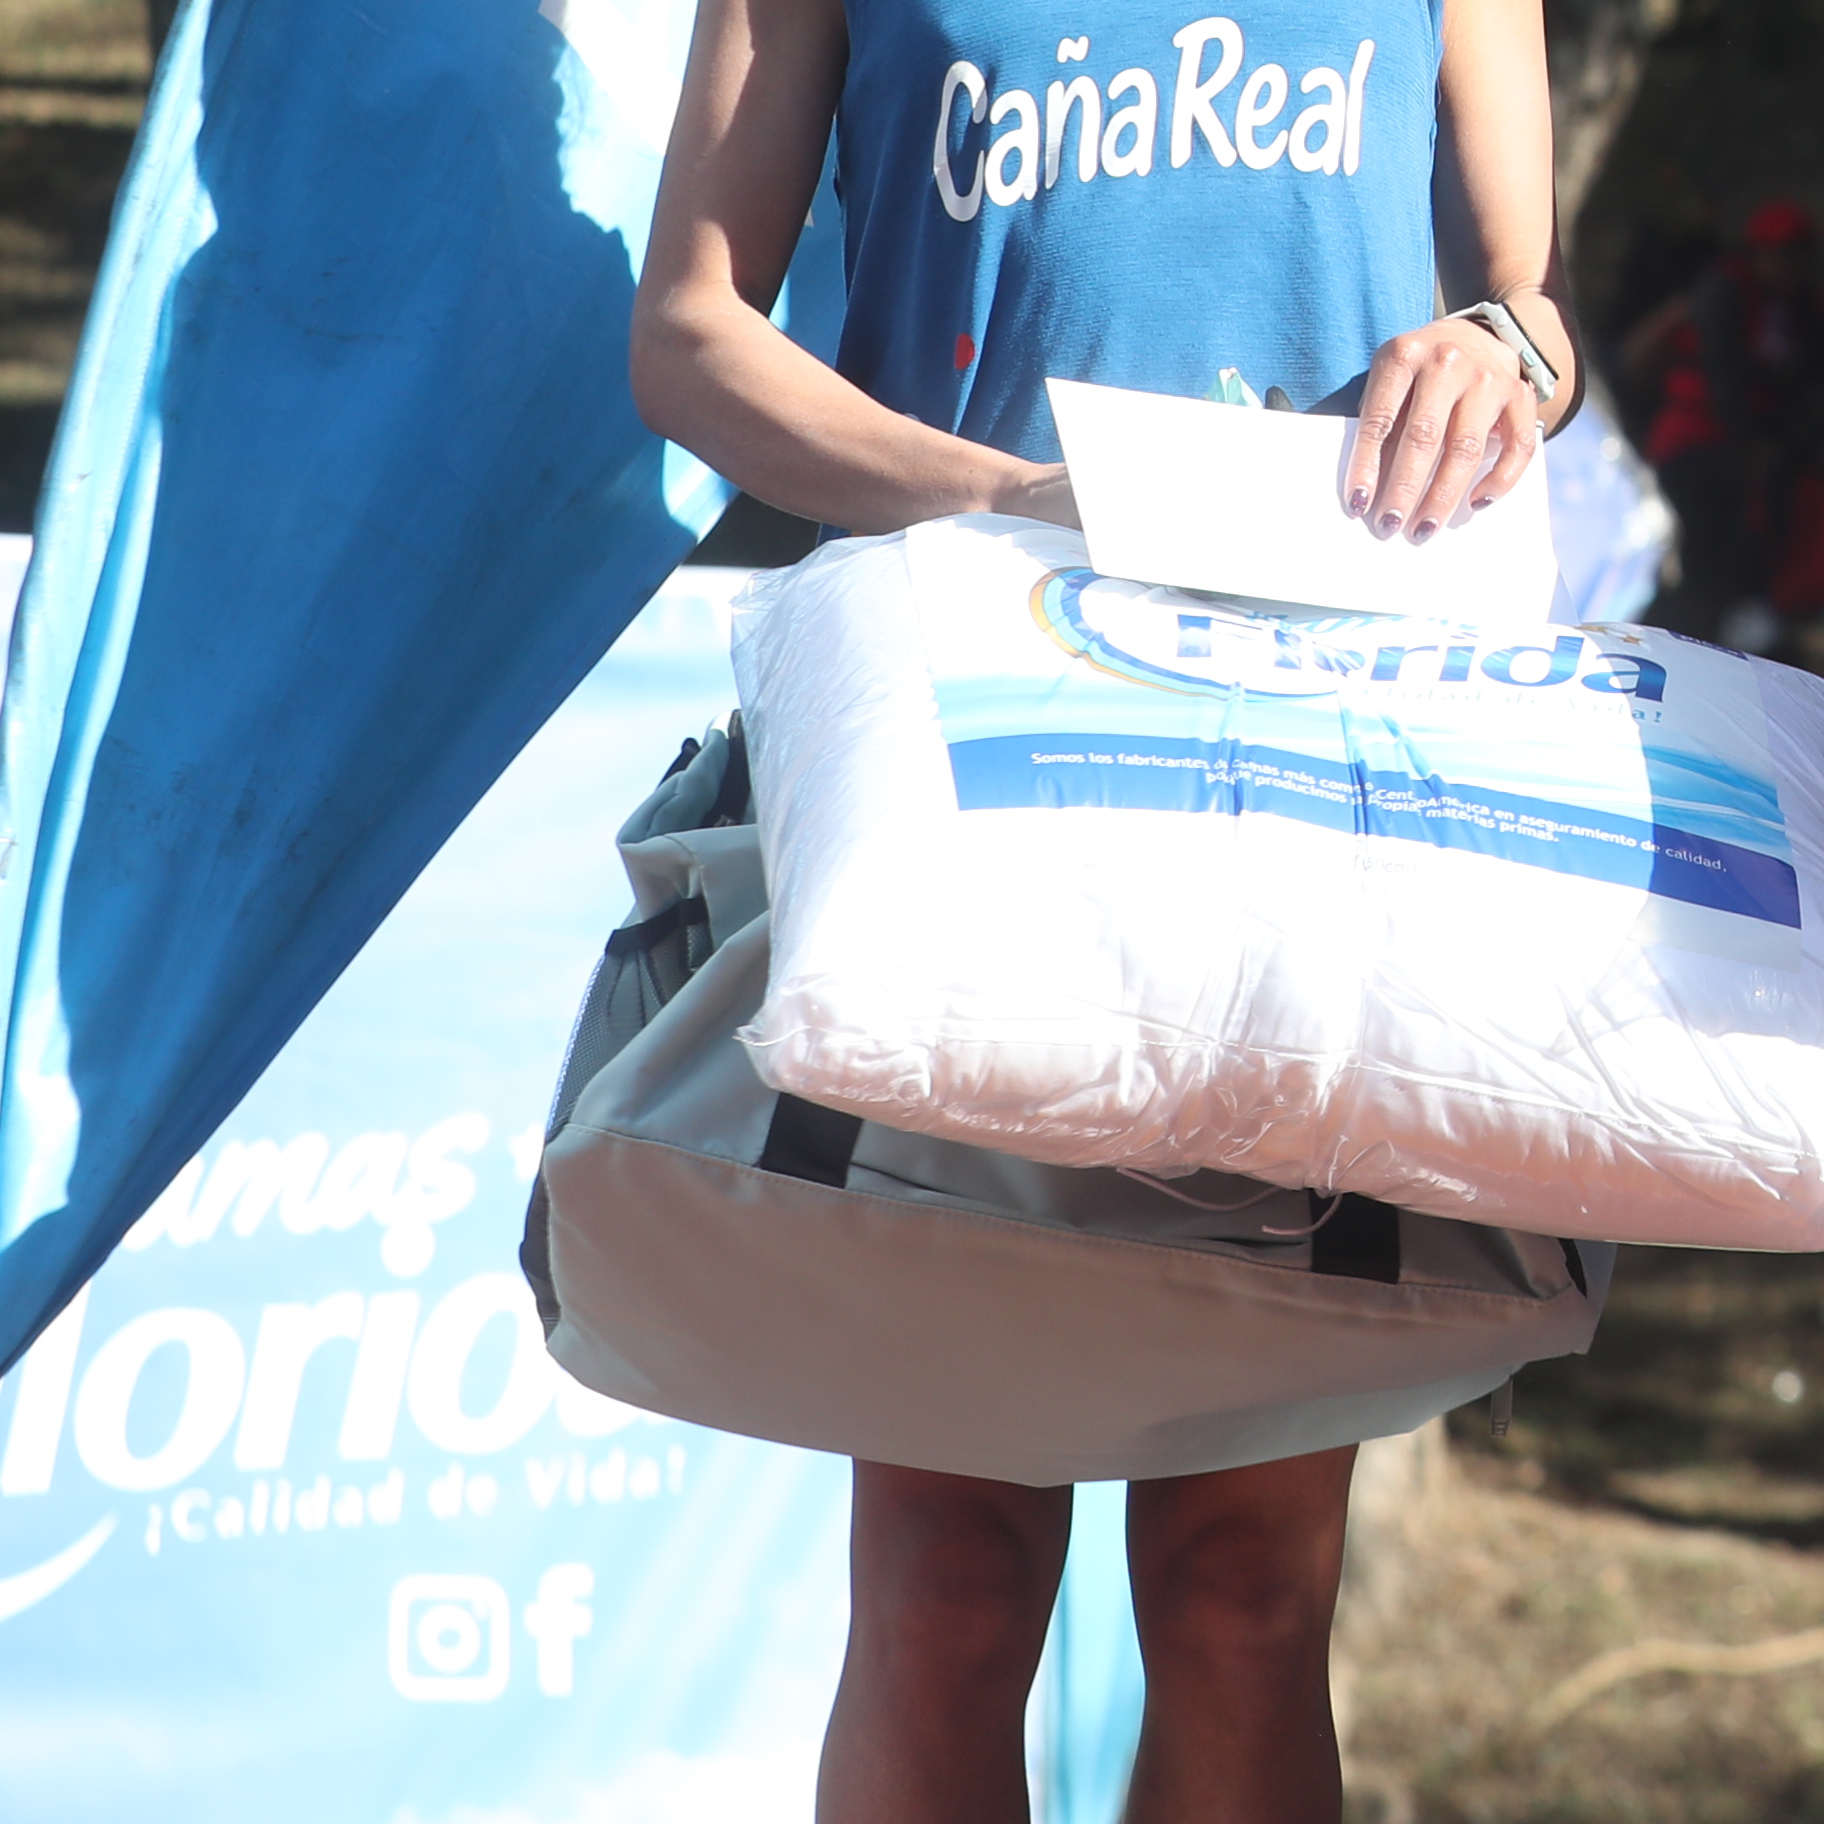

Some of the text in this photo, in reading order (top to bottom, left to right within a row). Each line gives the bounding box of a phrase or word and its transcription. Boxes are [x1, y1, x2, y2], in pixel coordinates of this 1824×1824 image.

[1031, 752, 1086, 765] Somos
[1089, 751, 1115, 765] los
[1117, 752, 1210, 770] fabricantes
[1284, 769, 1317, 786] más
[1254, 774, 1348, 804] producimos
[1426, 806, 1496, 830] materias
[1499, 821, 1560, 844] primas.
[1494, 808, 1516, 821] en
[1519, 812, 1637, 849] aseguramiento
[1665, 844, 1729, 874] calidad,
[144, 1441, 687, 1558] ¡Calidad de Vida!
